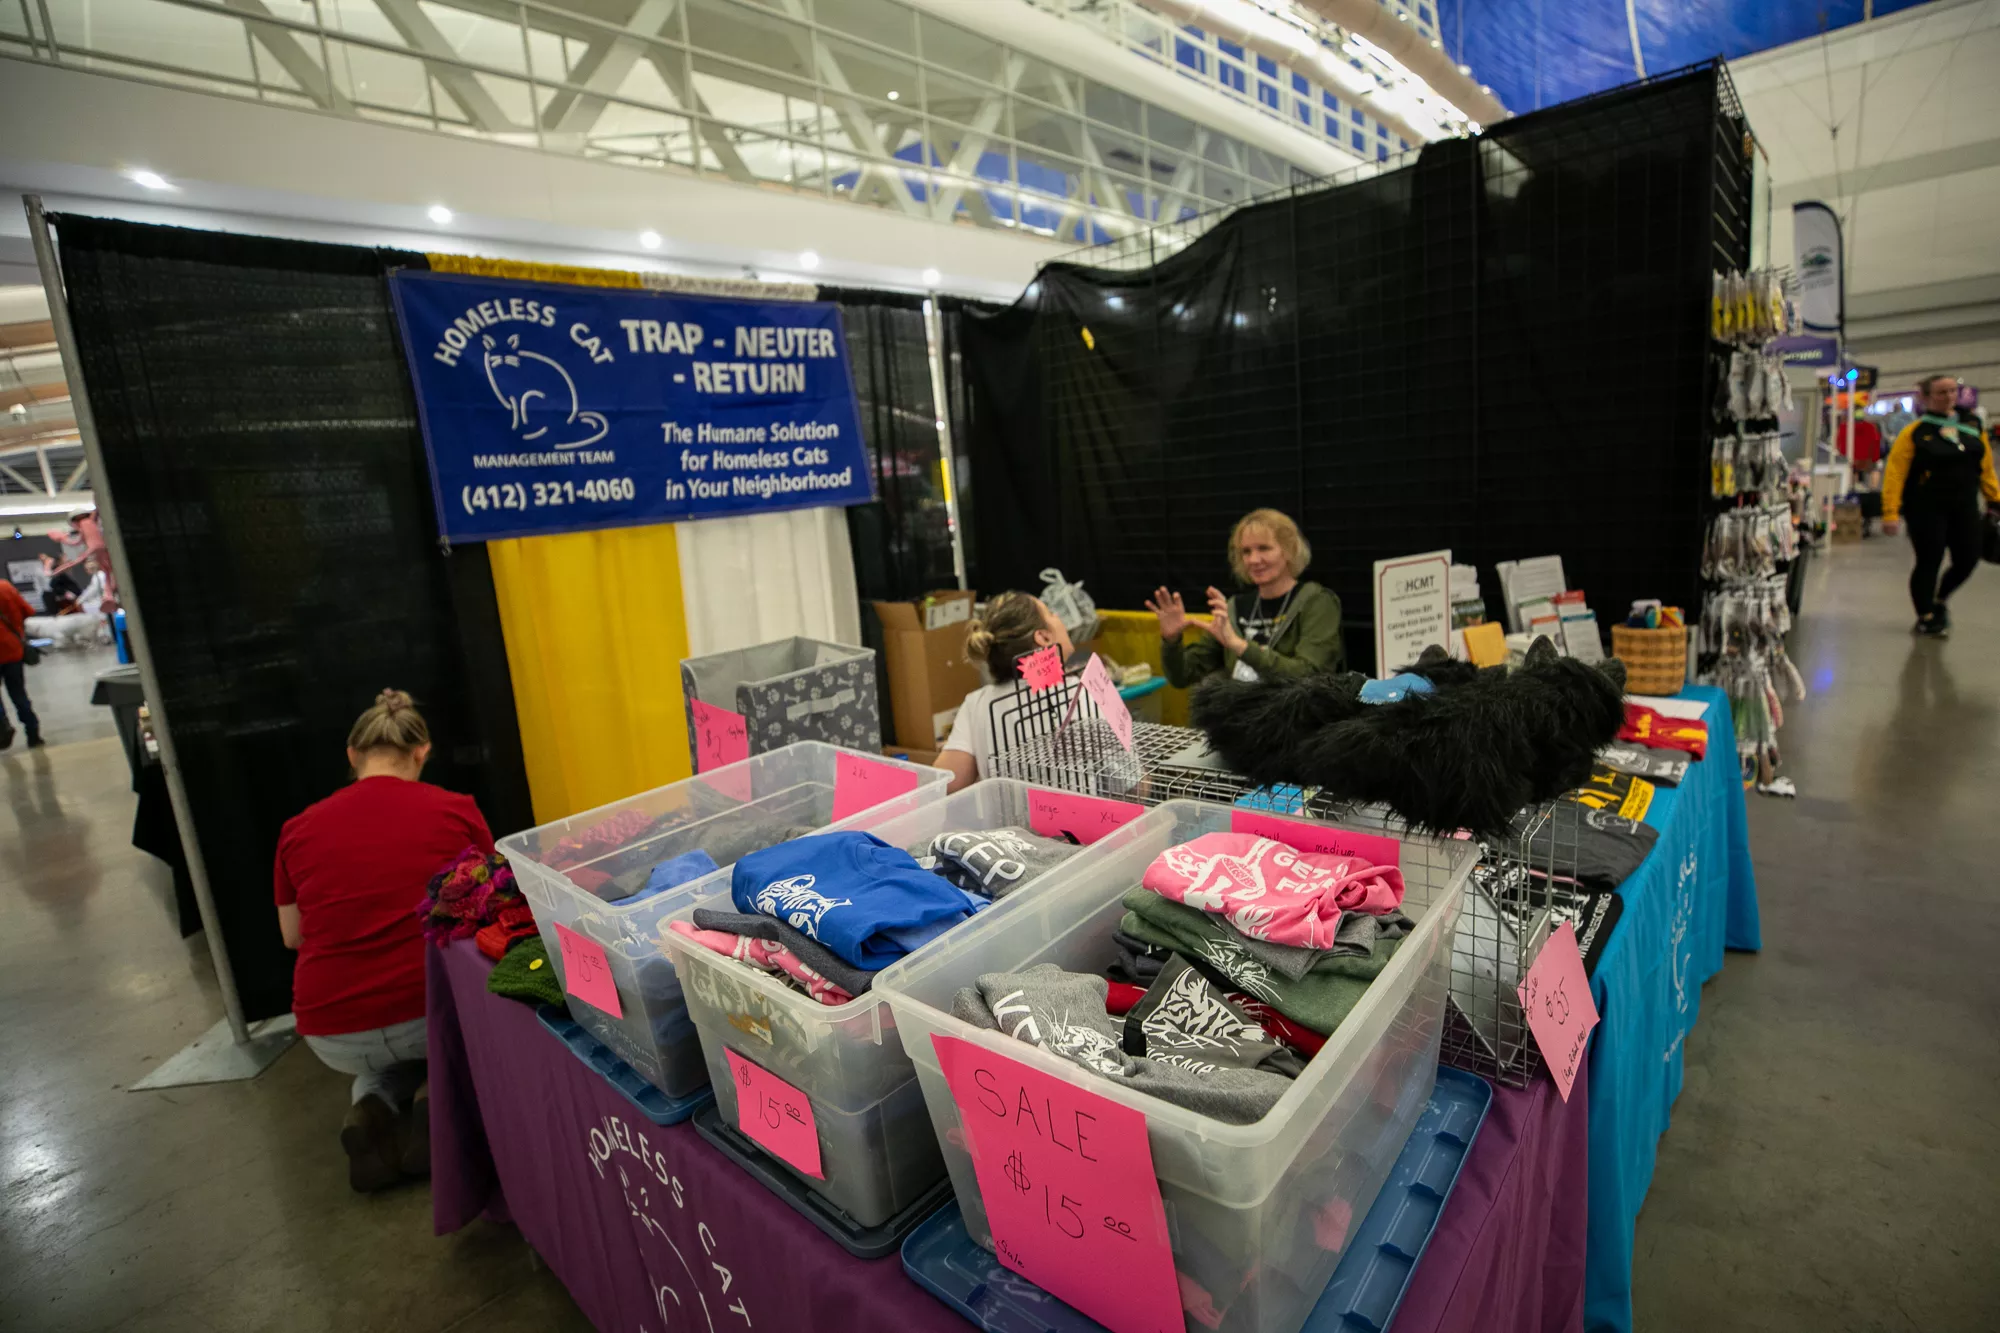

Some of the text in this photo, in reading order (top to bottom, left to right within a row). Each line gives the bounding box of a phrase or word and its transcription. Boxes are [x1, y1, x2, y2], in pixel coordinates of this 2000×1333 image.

[433, 298, 615, 367] HOMELESS CAT
[619, 319, 837, 358] TRAP - NEUTER
[673, 362, 806, 395] - RETURN
[662, 421, 839, 444] The Humane Solution
[473, 450, 615, 469] MANAGEMENT TEAM
[680, 447, 829, 472] for Homeless Cats
[461, 476, 635, 516] (412) 321-4060
[665, 467, 852, 500] in Your Neighborhood
[1405, 575, 1435, 591] HCMT
[1315, 840, 1356, 857] medium
[1273, 851, 1331, 880] GET
[738, 1063, 751, 1088] $
[759, 1090, 780, 1129] 15
[974, 1069, 1097, 1162] SALE
[1003, 1150, 1031, 1195] $
[1045, 1185, 1084, 1239] 15
[588, 1116, 684, 1208] HOMELESS
[698, 1222, 752, 1328] CAT
[996, 1239, 1025, 1269] Sale
